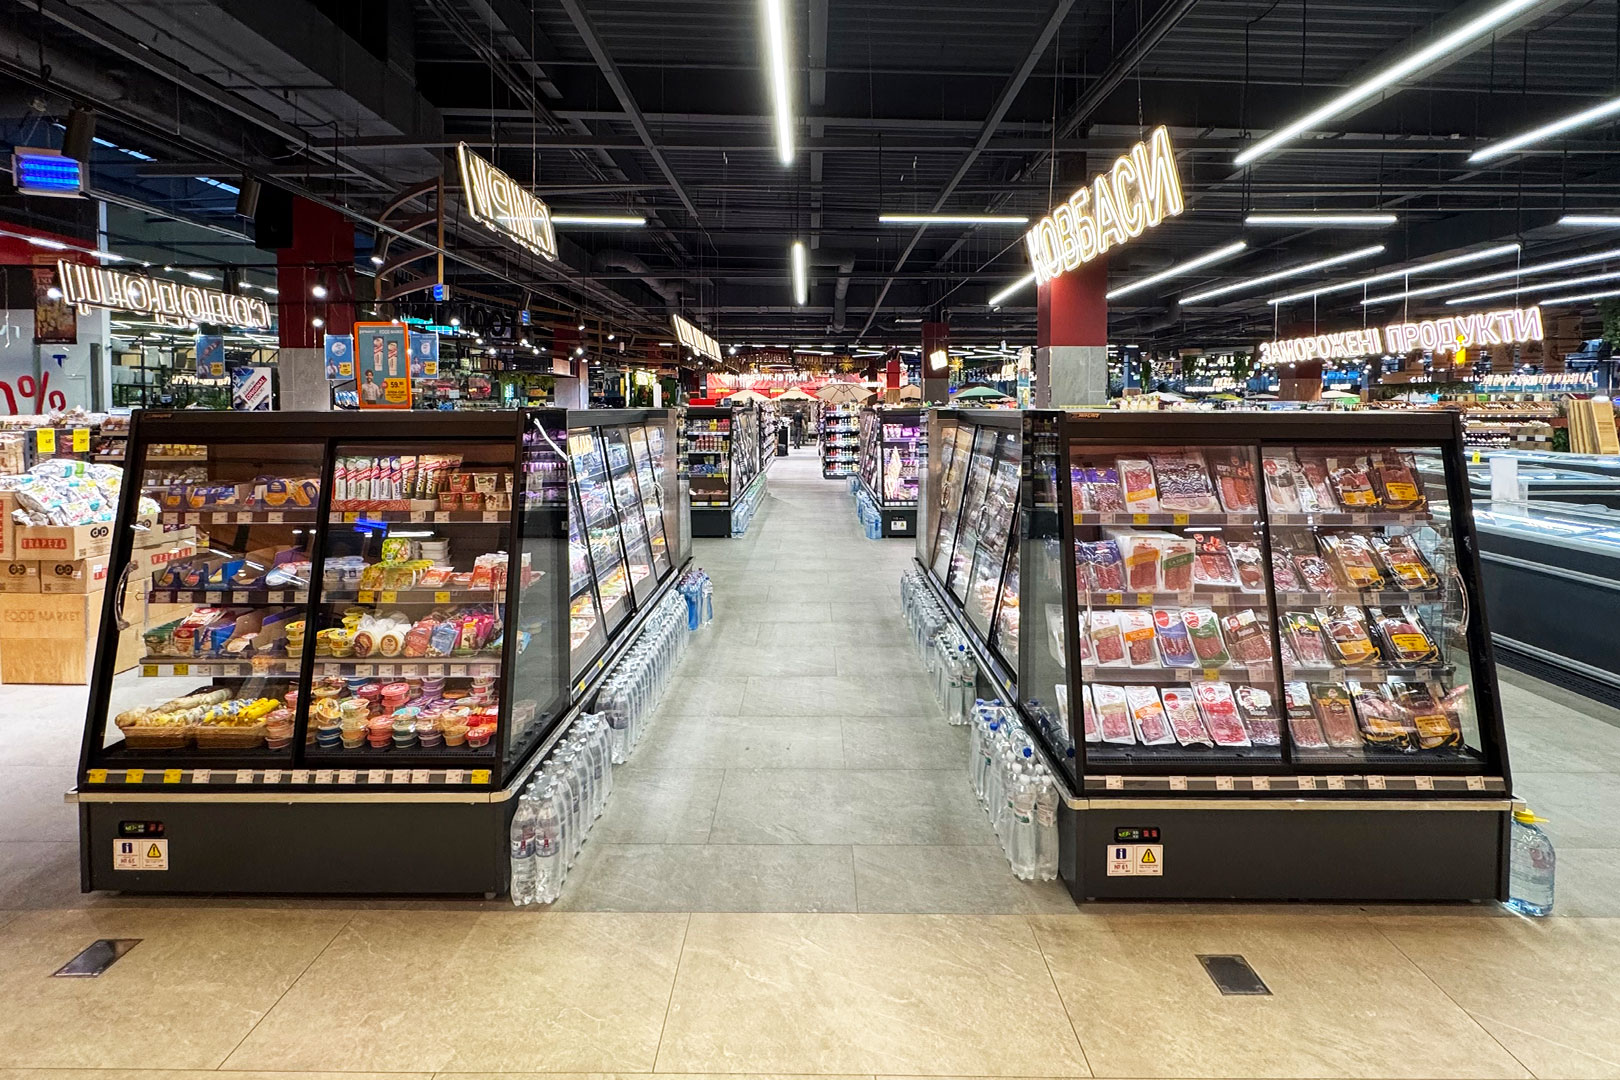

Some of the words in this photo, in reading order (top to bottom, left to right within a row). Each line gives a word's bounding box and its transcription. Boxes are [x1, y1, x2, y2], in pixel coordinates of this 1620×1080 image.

[1026, 124, 1185, 286] КОВБАСИ
[1259, 327, 1382, 364] ЗАМОРОЖЕНІ
[1384, 306, 1544, 353] ПРОДУКТИ
[22, 538, 66, 549] TRAPEZA
[5, 610, 35, 622] FOOD
[39, 610, 81, 622] MARKET
